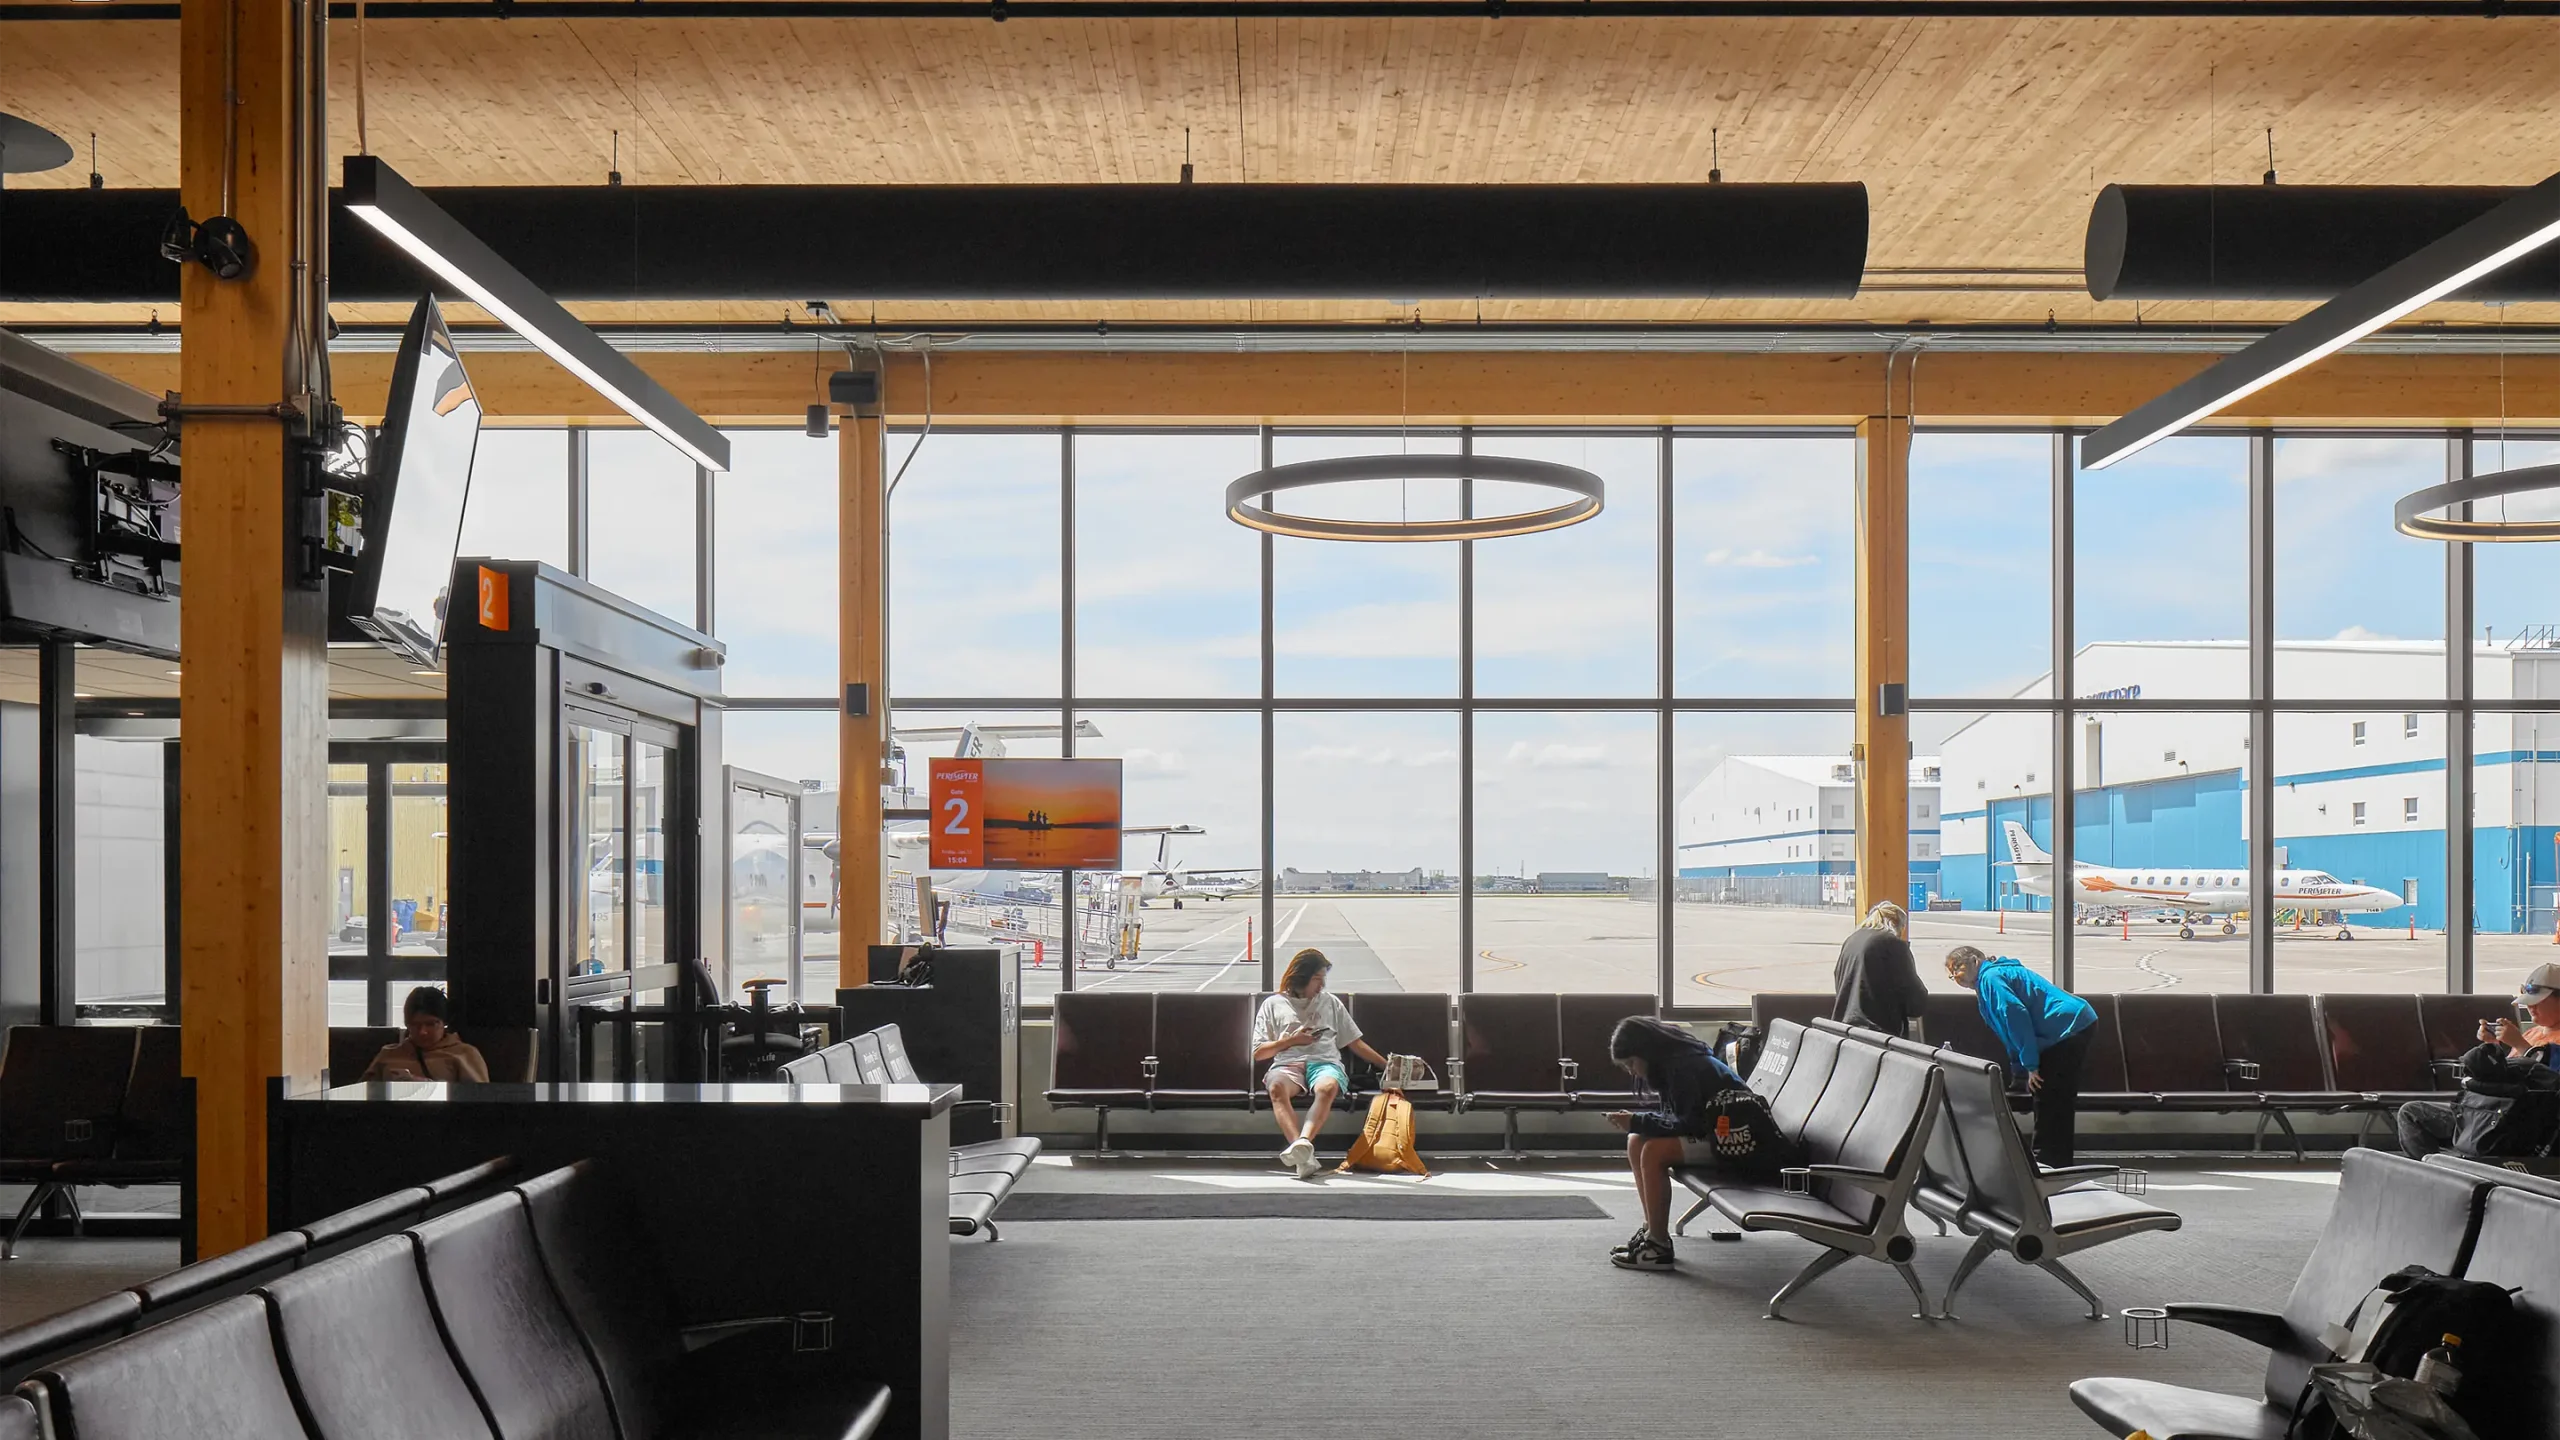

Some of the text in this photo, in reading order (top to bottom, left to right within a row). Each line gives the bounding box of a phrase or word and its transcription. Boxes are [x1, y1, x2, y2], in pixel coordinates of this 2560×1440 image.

[482, 576, 494, 620] 2
[936, 771, 979, 781] PERIMETER
[943, 797, 970, 835] 2
[947, 856, 968, 864] 15:04
[2298, 887, 2342, 895] PERIMETER
[1715, 1128, 1752, 1144] VANS
